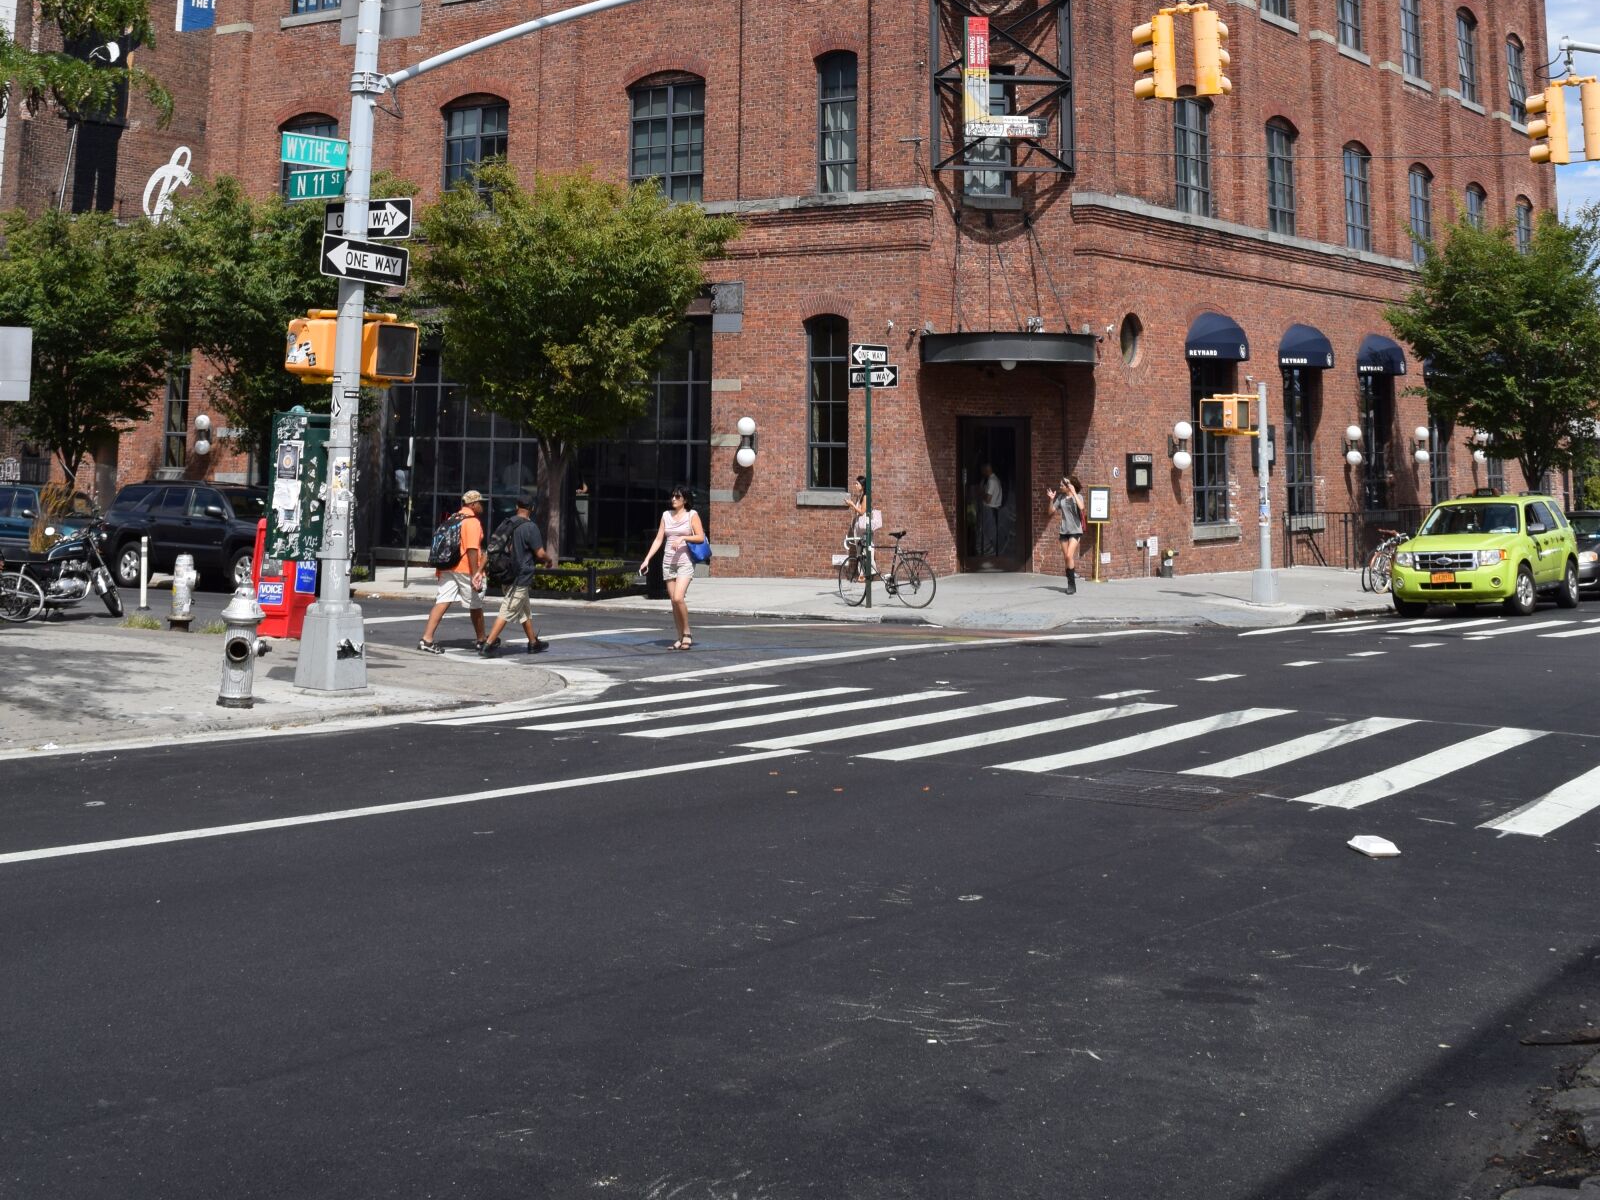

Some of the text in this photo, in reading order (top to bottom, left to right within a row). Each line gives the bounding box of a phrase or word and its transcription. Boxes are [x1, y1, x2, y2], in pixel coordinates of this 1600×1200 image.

[286, 137, 346, 163] WYTHE AV
[297, 173, 341, 196] N 11 St
[372, 211, 398, 227] WAY
[345, 251, 399, 273] ONE WAY
[871, 351, 884, 360] WAY
[876, 372, 891, 381] WAY
[260, 584, 284, 594] VOICE
